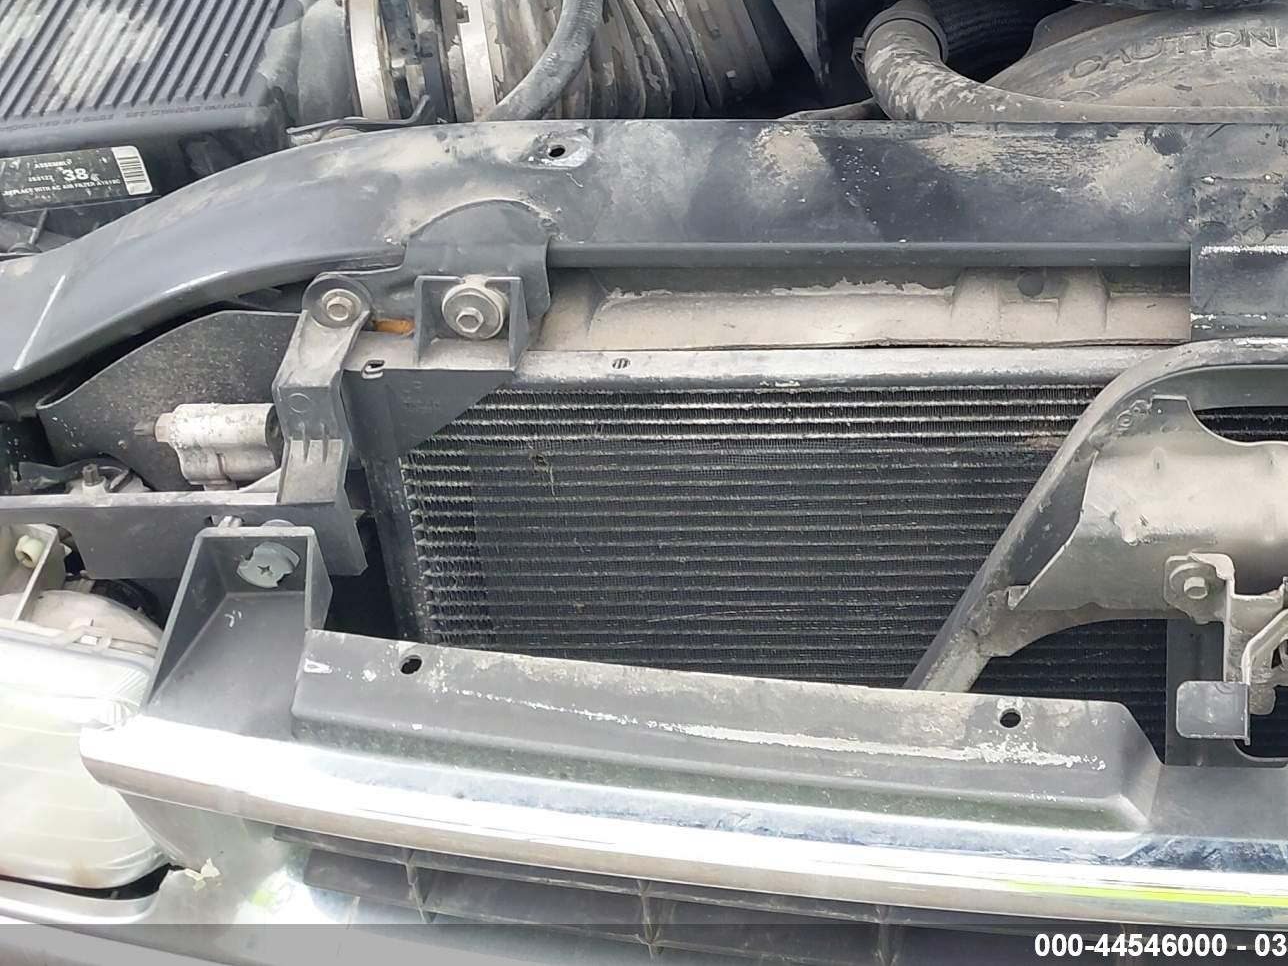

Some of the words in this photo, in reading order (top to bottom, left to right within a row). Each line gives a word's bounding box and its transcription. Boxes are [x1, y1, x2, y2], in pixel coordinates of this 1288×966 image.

[1069, 25, 1280, 81] CAUTION
[62, 167, 89, 182] 38
[33, 185, 51, 193] WITH
[75, 181, 95, 189] FILTER
